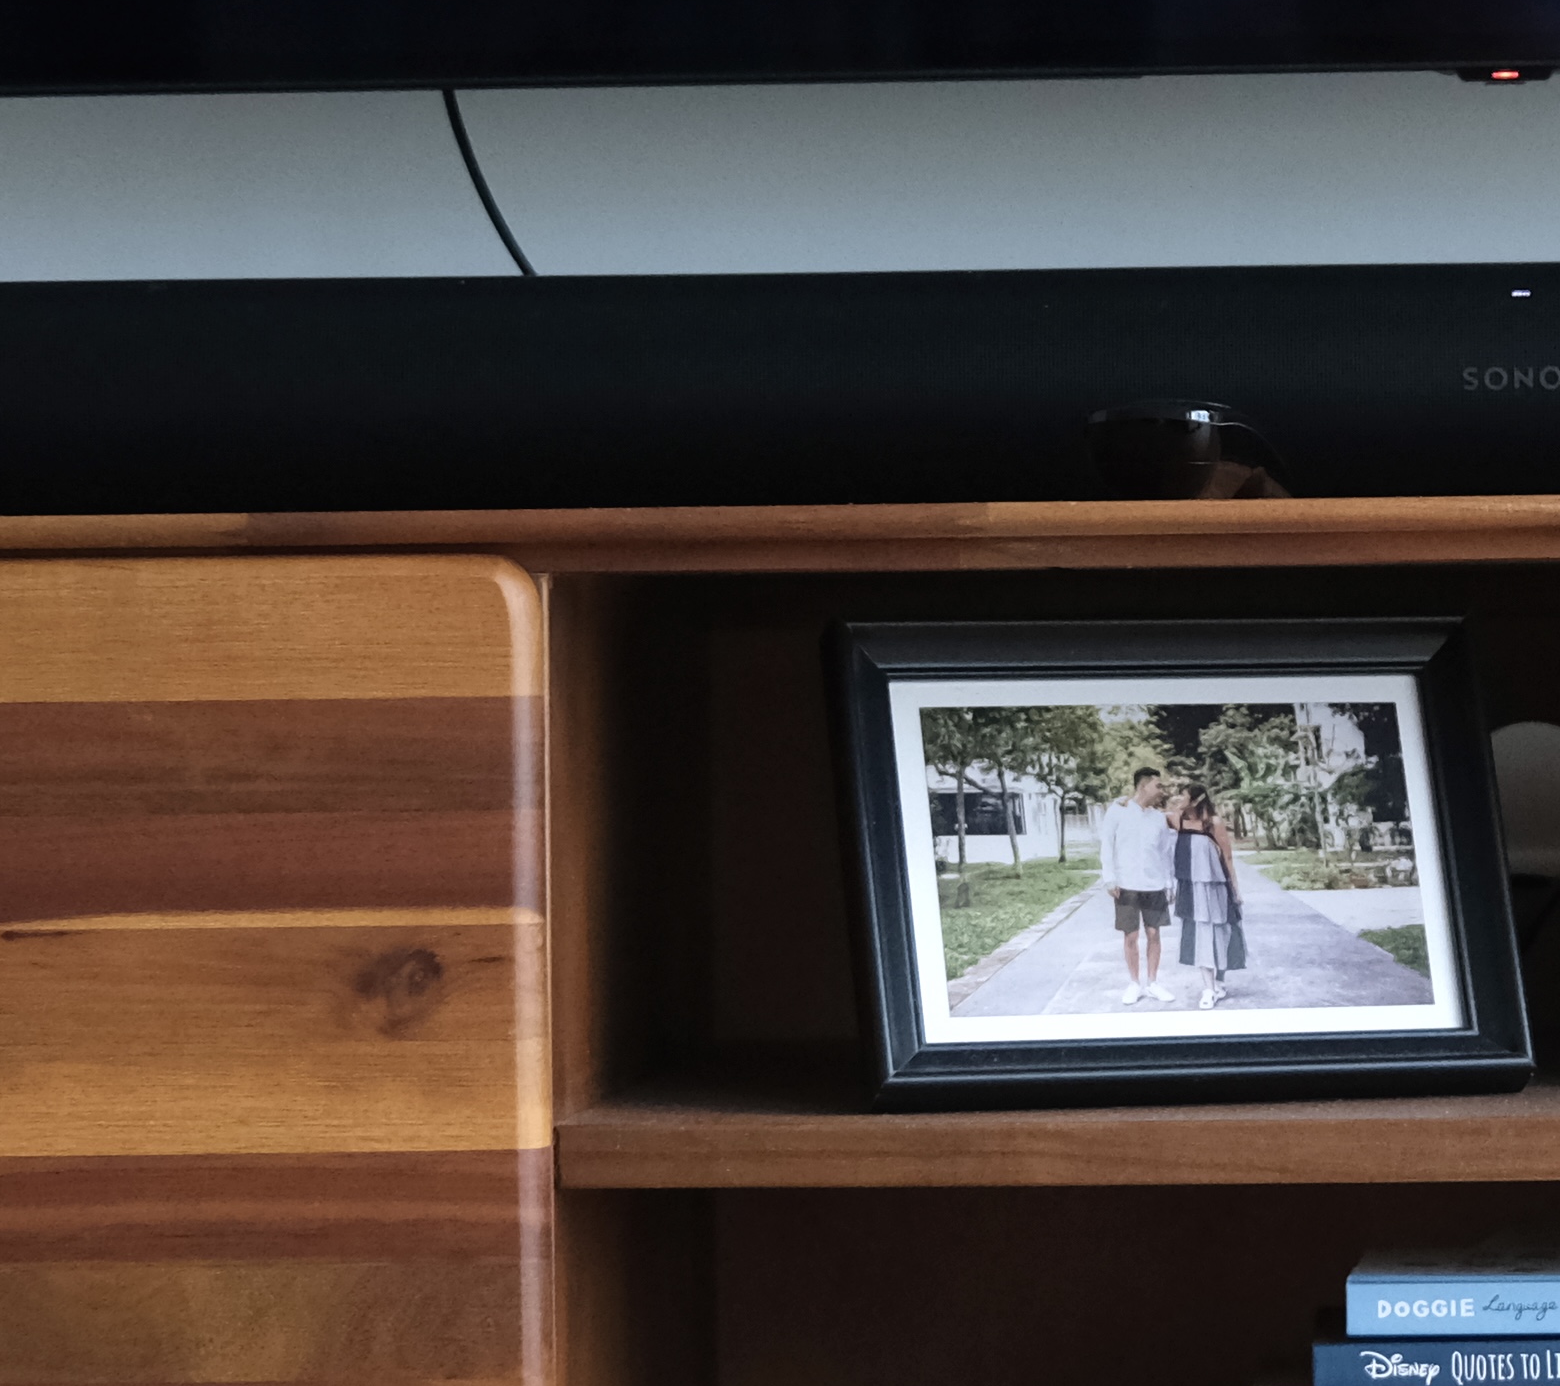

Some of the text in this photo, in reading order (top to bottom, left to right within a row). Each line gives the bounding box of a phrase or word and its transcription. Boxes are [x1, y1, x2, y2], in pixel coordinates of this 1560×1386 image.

[1377, 1294, 1559, 1321] DOGGIE Language
[1359, 1350, 1441, 1386] Disney
